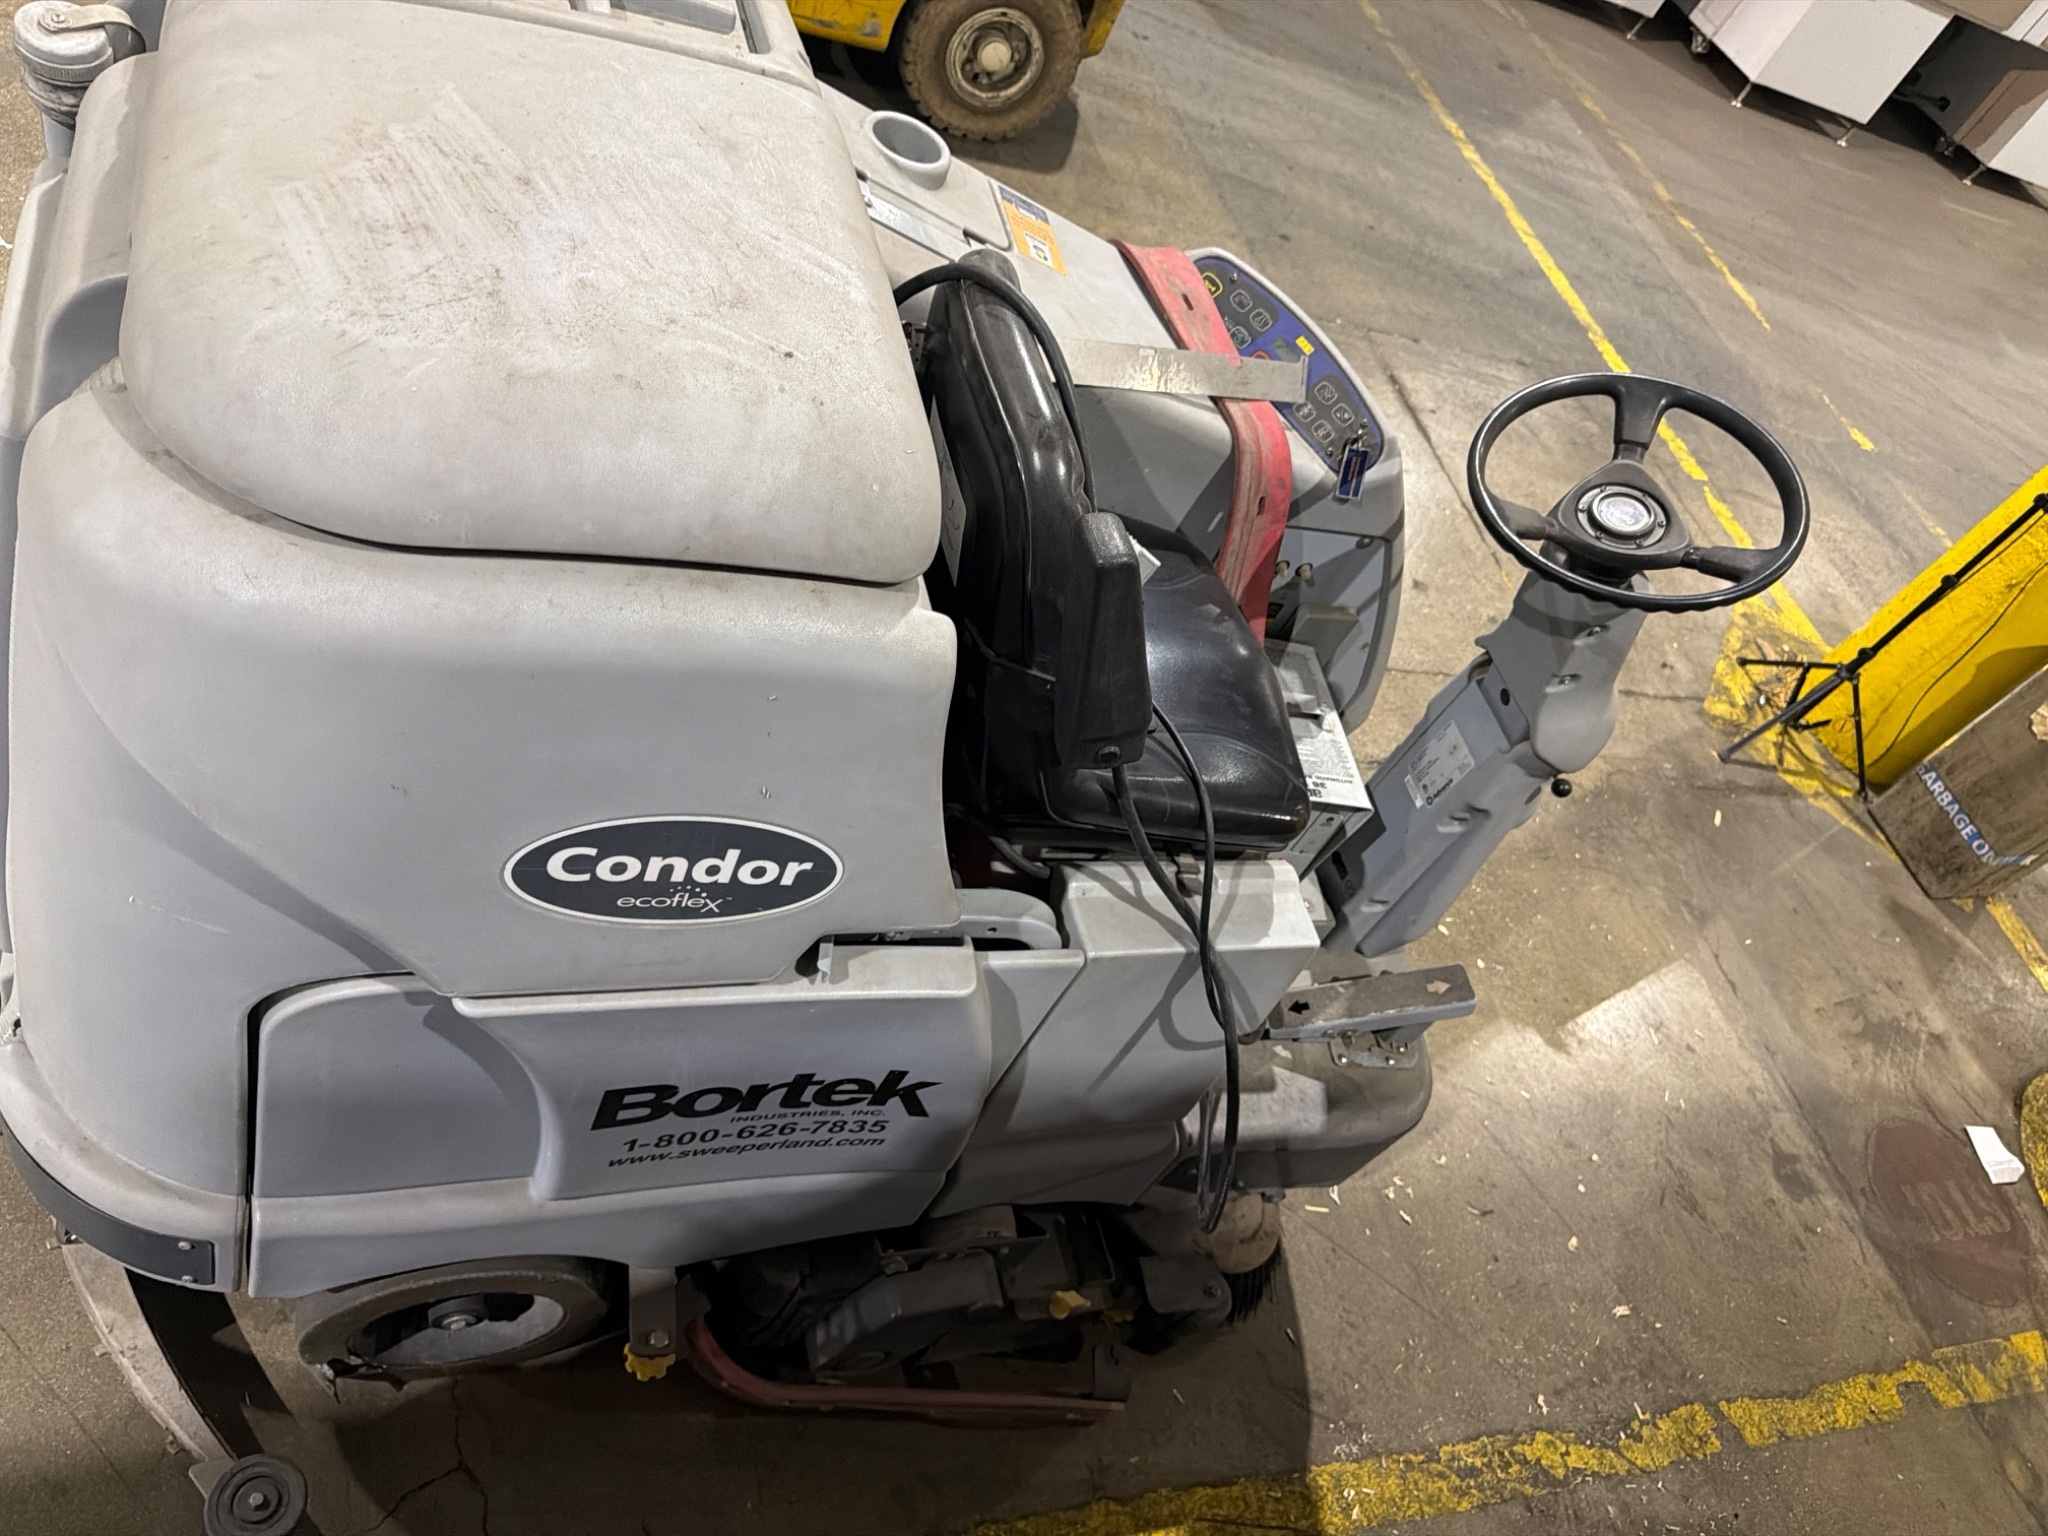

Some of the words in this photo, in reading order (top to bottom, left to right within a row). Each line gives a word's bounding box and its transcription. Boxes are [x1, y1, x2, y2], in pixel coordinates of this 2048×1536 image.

[546, 846, 815, 886] Condor
[616, 892, 724, 913] ecoflex
[590, 1069, 944, 1131] Bortek
[607, 1136, 886, 1168] www.sweeperland.com
[622, 1119, 890, 1153] 1-800-626-7835
